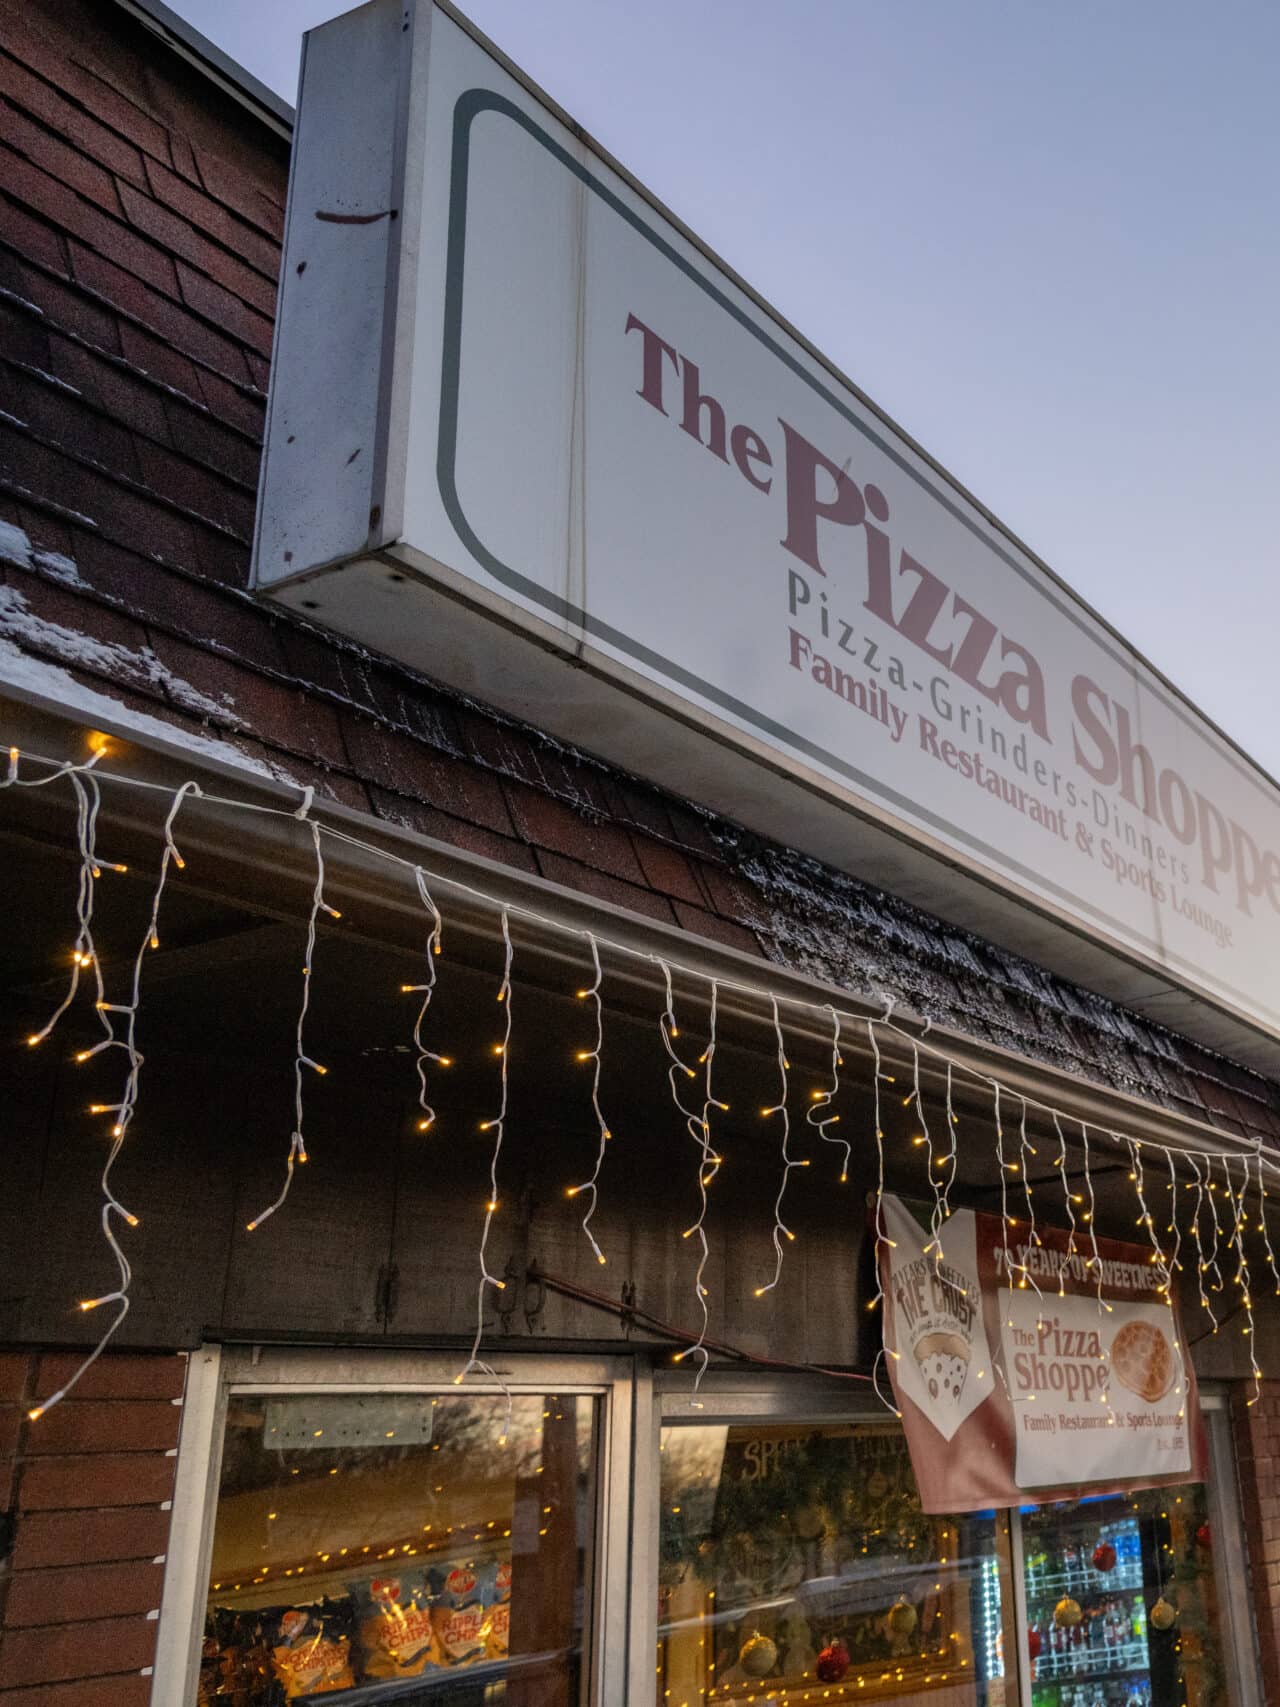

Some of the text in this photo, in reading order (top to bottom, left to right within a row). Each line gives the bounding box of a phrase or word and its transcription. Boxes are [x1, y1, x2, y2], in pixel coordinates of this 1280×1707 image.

[625, 312, 773, 496] The
[777, 416, 1054, 745] Pizza
[788, 627, 1235, 949] Family Restaurant & Sports Lounge
[1012, 1317, 1101, 1359] The Pizza
[1014, 1352, 1110, 1402] Shoppe
[1023, 1414, 1056, 1434] Family
